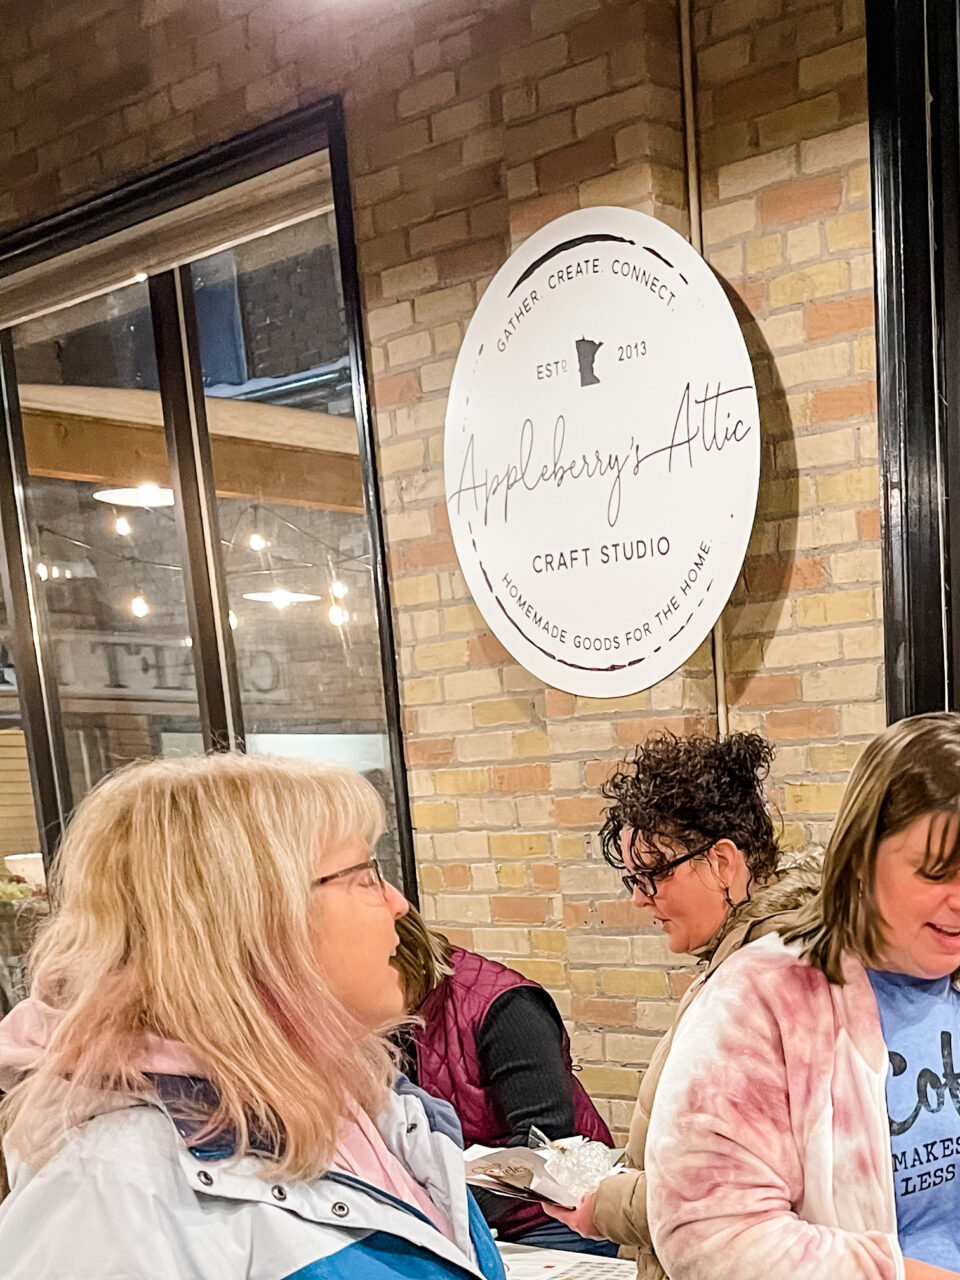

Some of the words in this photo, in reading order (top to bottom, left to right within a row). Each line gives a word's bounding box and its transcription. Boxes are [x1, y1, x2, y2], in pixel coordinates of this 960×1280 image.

[548, 258, 604, 288] CREATE.
[611, 258, 676, 312] CONNECT.
[617, 340, 648, 363] 2013
[448, 414, 642, 528] Appleberry's
[668, 381, 754, 473] Attic
[532, 547, 591, 575] CRAFT
[600, 535, 671, 565] STUDIO
[501, 572, 568, 644] HOMEMADE
[573, 632, 621, 653] GOODS
[625, 623, 652, 647] FOR
[655, 595, 681, 628] THE
[901, 1163, 956, 1197] LESS
